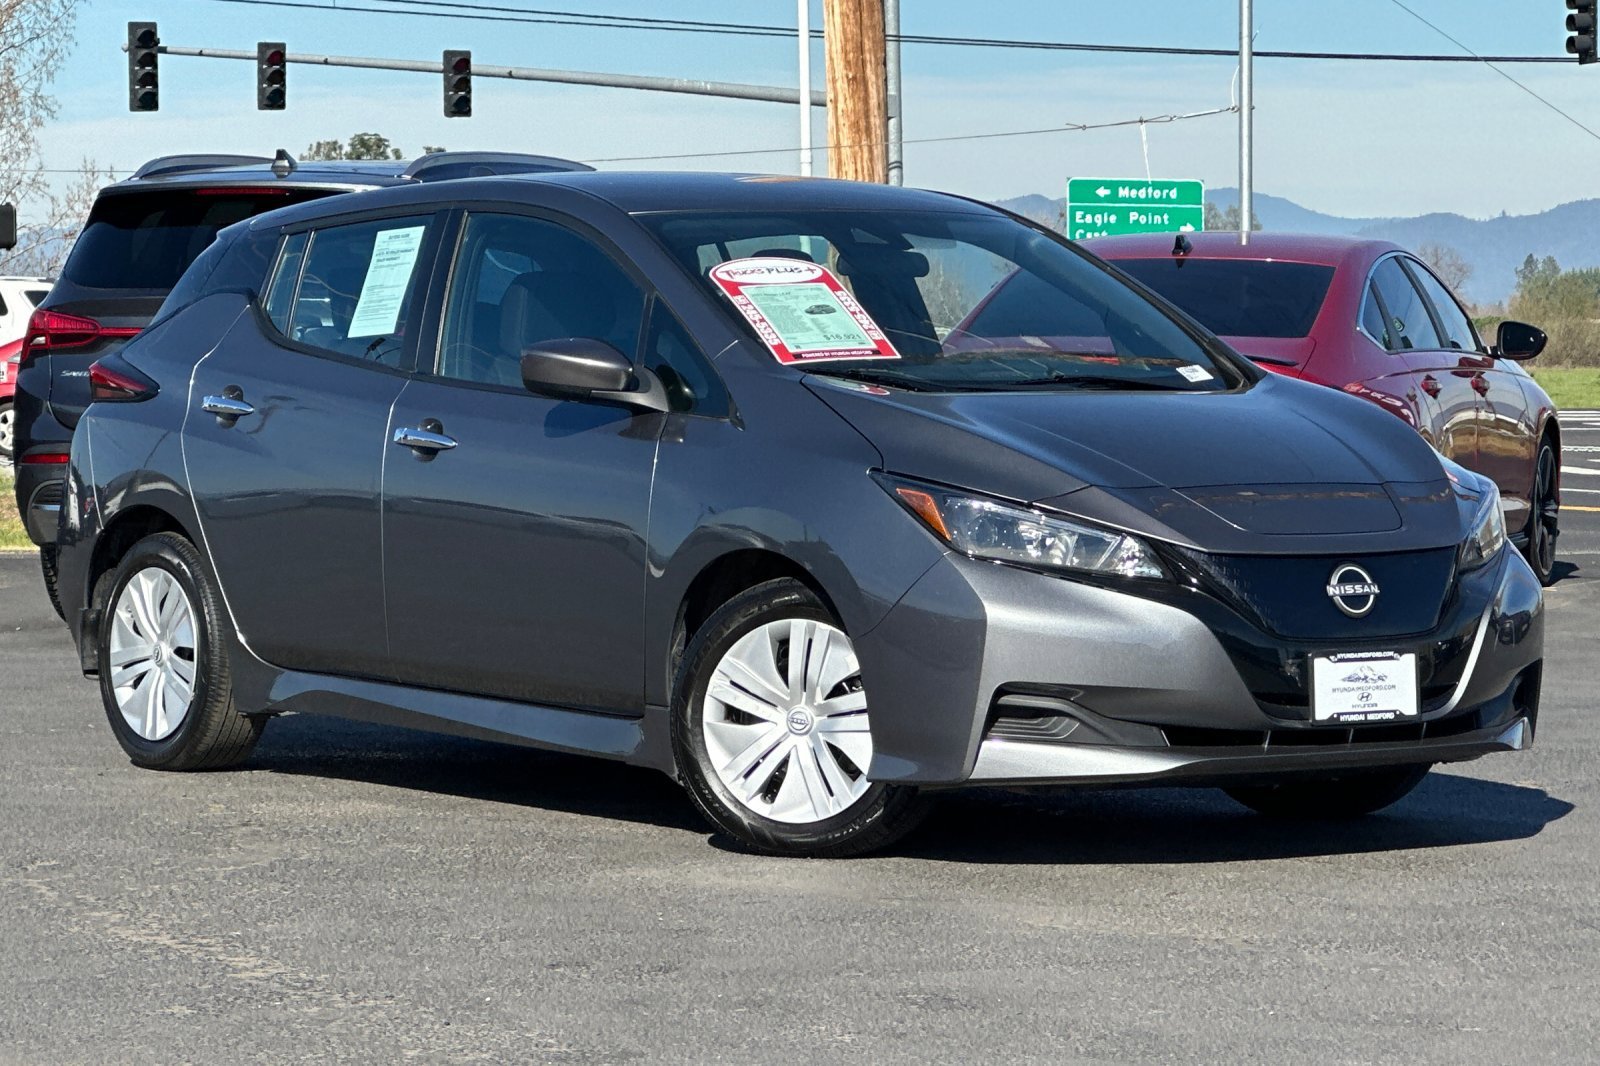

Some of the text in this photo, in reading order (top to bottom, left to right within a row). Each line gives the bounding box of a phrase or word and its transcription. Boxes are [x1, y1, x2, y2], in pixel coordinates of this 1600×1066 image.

[1118, 186, 1177, 199] Medford
[1075, 211, 1169, 226] Eagle Point
[1326, 584, 1380, 596] NISSAN
[1339, 712, 1395, 722] HYUNDAI MEDFORD
